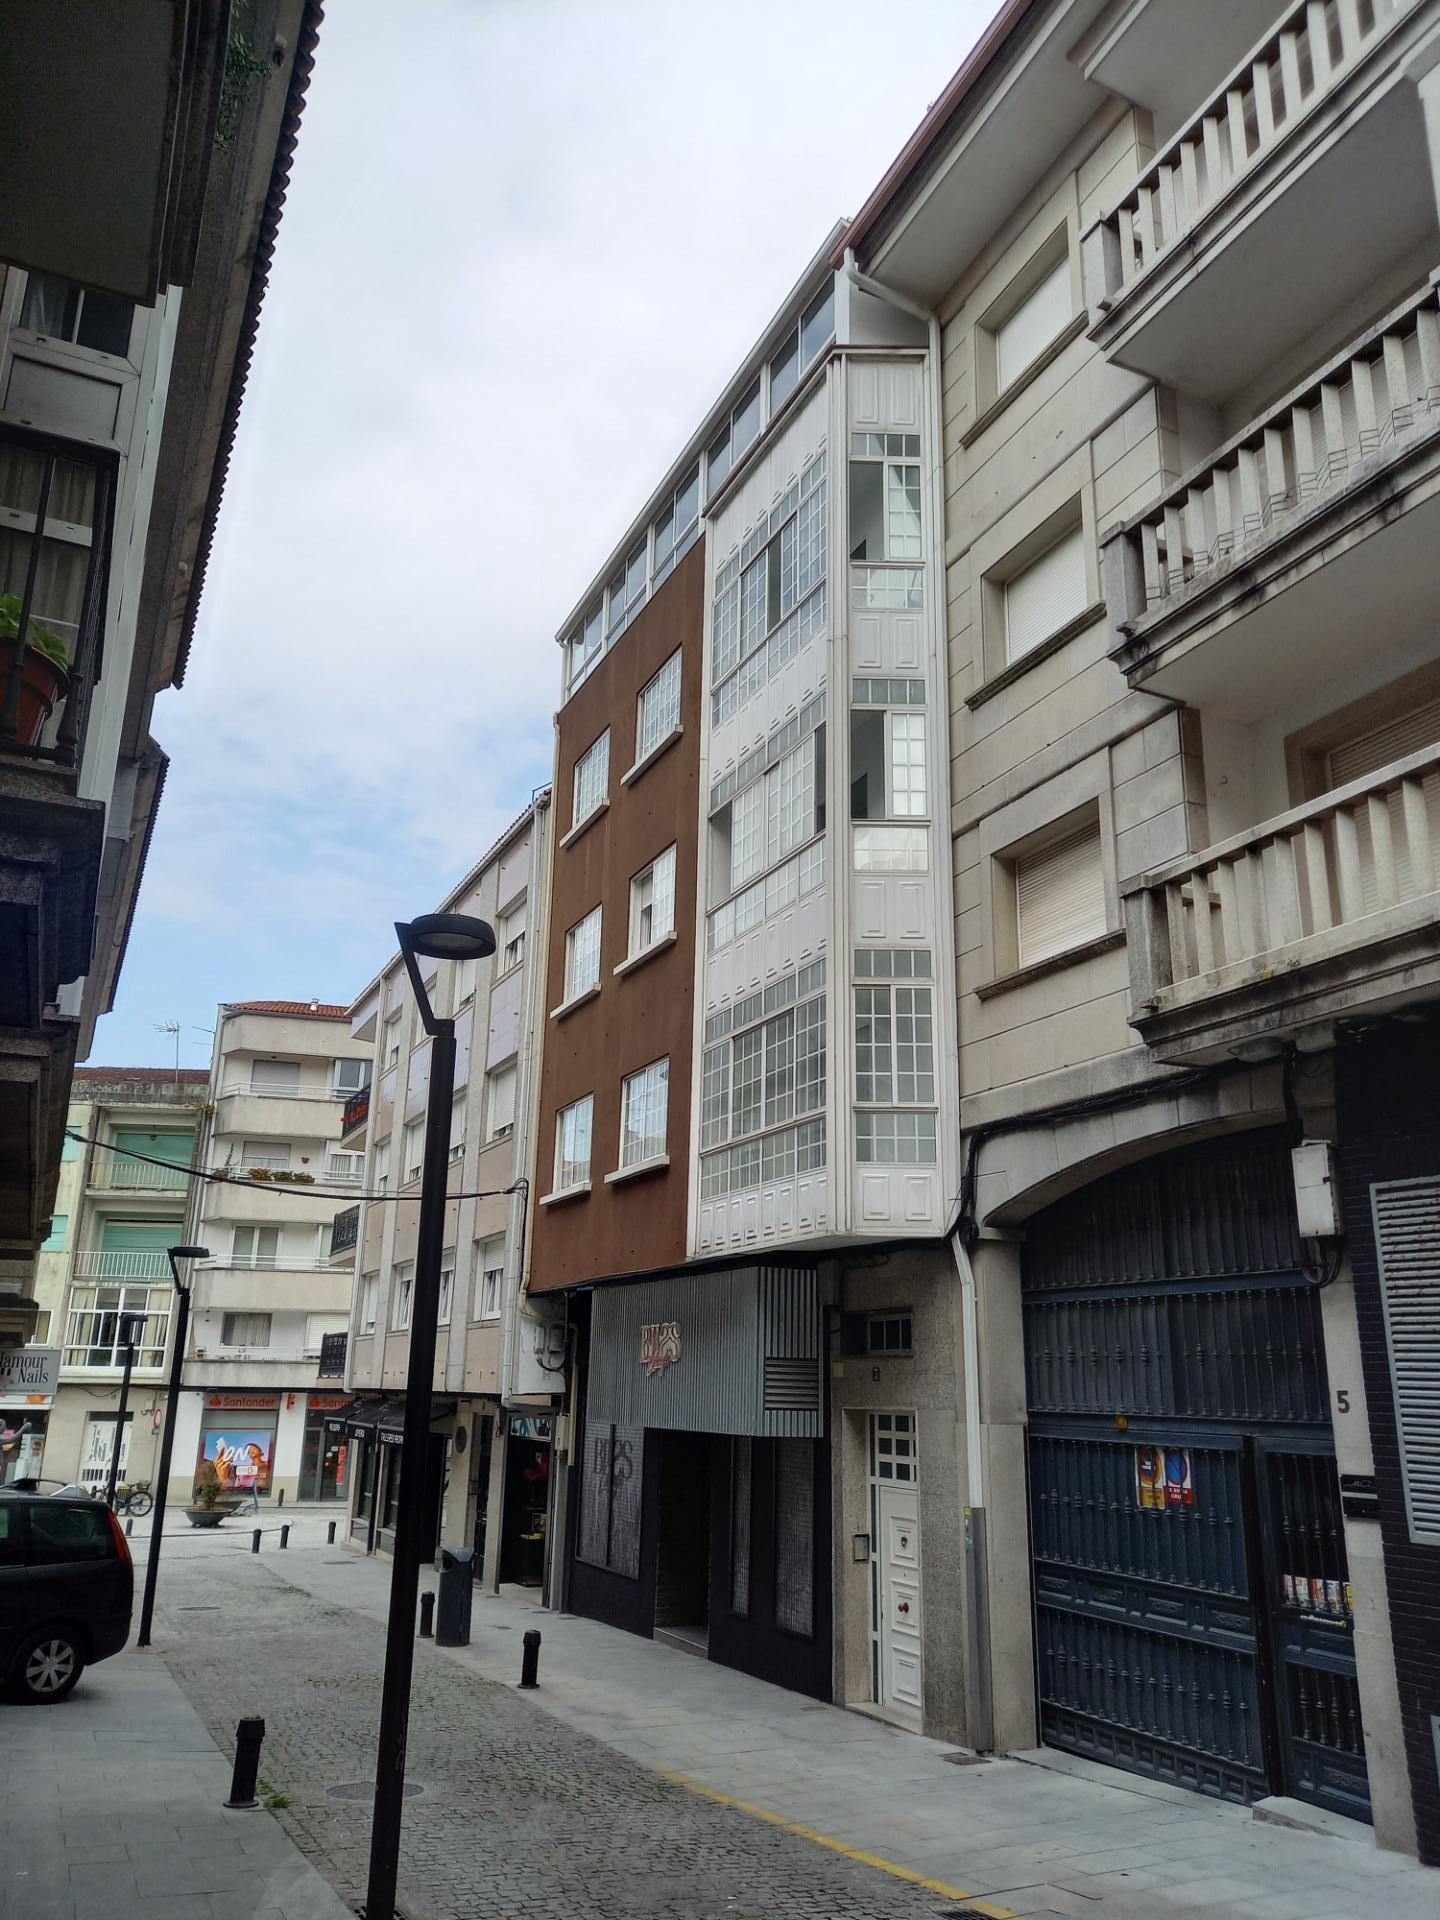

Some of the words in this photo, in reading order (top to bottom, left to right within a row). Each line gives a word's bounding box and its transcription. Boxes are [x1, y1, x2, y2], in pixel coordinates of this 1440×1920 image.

[18, 1368, 49, 1384] Nails
[223, 1396, 275, 1408] Santander
[1337, 1390, 1350, 1413] 5
